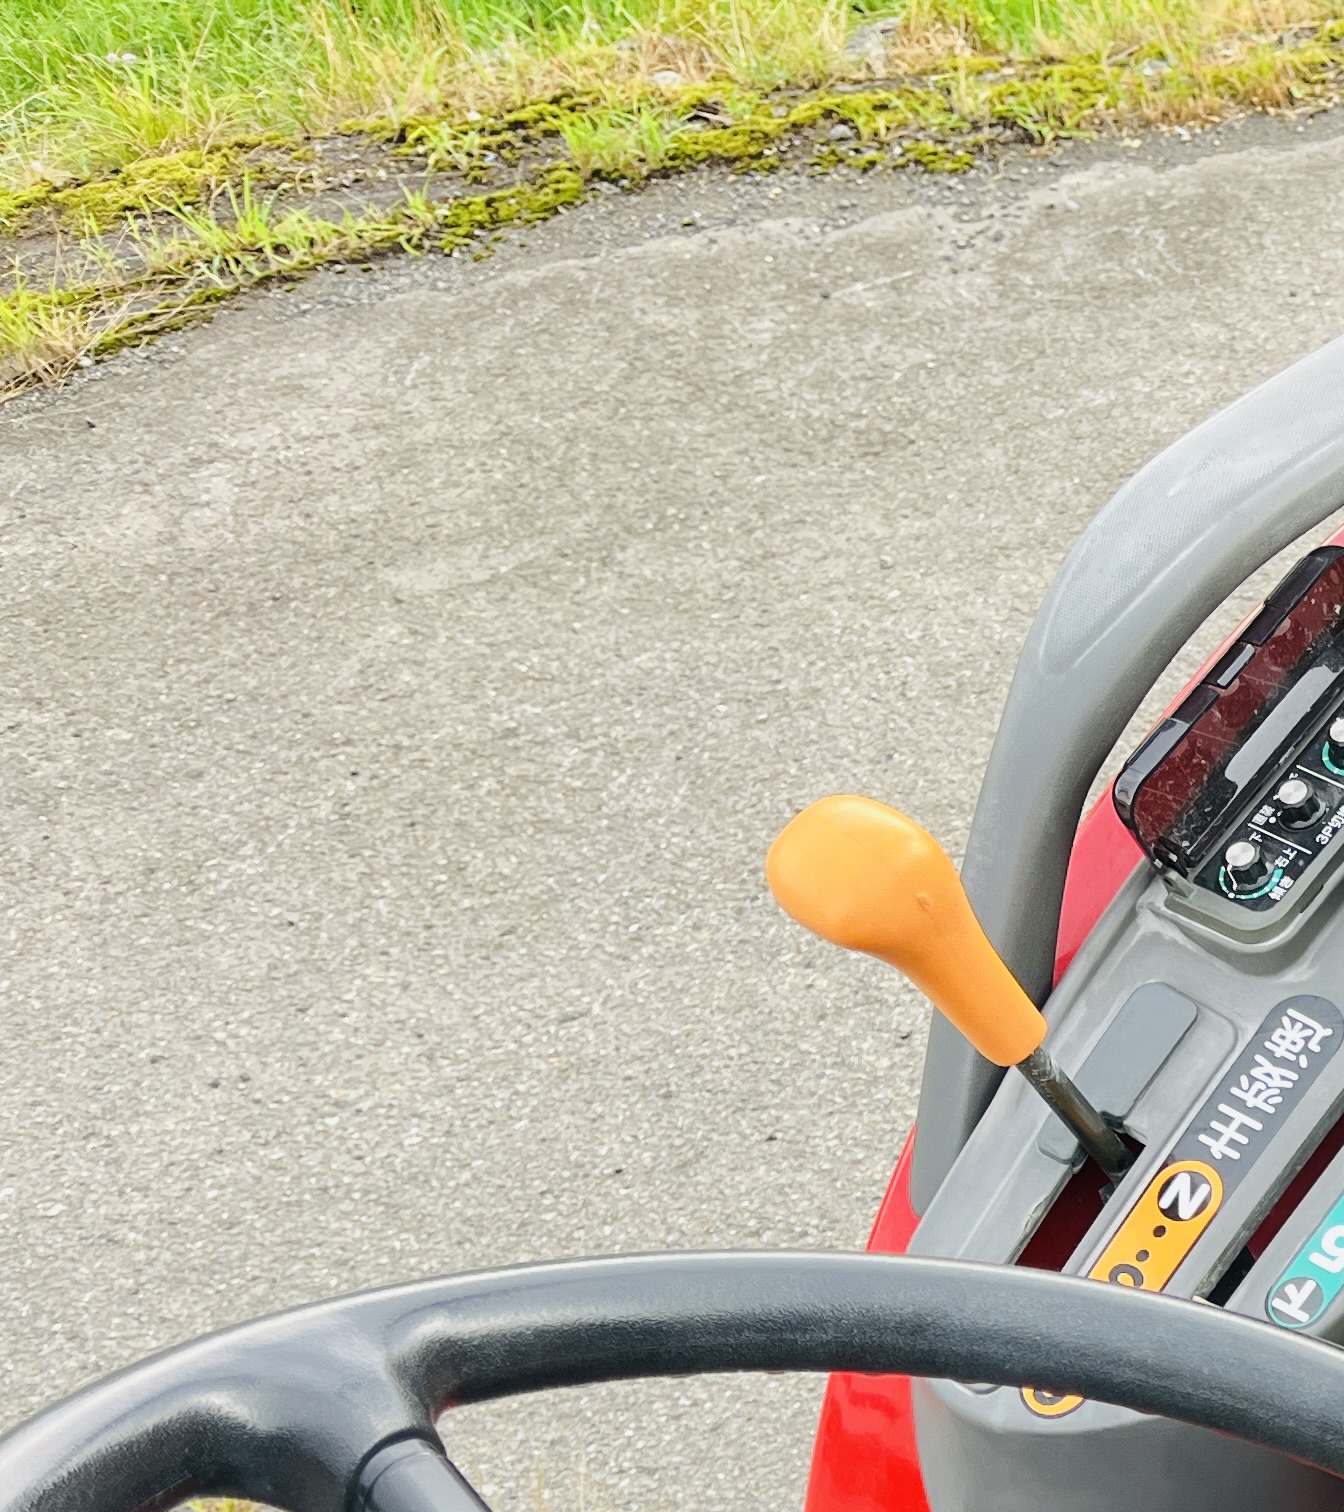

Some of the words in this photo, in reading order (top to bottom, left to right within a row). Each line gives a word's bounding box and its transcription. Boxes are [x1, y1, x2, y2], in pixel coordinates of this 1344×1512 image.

[1197, 1007, 1334, 1161] 主変速
[1157, 1170, 1212, 1221] N
[1270, 1278, 1318, 1324] 下
